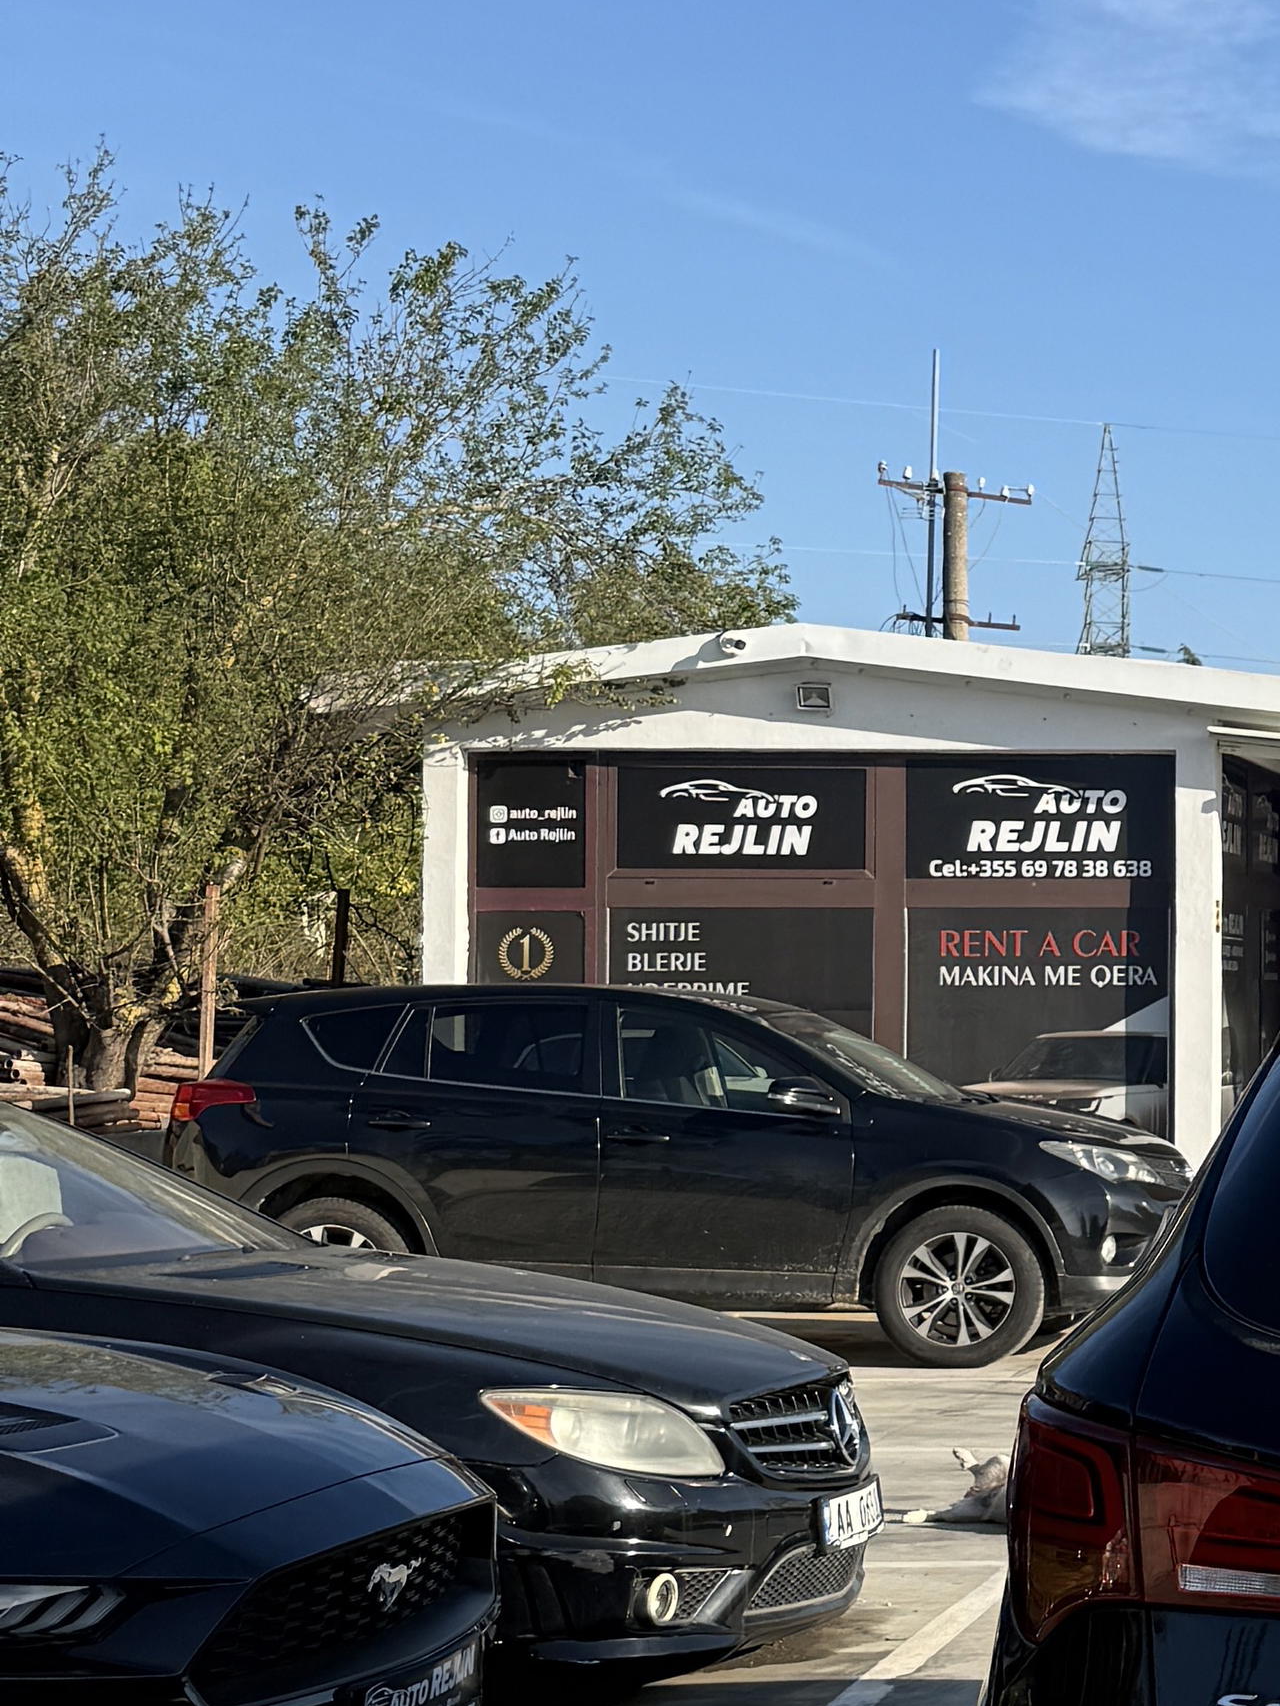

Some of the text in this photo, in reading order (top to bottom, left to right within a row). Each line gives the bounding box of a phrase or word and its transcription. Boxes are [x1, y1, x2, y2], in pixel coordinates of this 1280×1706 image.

[733, 794, 819, 819] AUTO
[1033, 789, 1128, 814] AUTO
[507, 828, 538, 841] Auto
[672, 823, 813, 856] REJLIN
[966, 820, 1122, 853] REJLIN
[929, 859, 1152, 878] Cel:+355 69 78 38 638
[626, 922, 700, 942] SHITJE
[938, 929, 1140, 958] RENT A CAR
[627, 952, 706, 972] BLERJE
[939, 964, 1158, 988] MAKINA ME QERA
